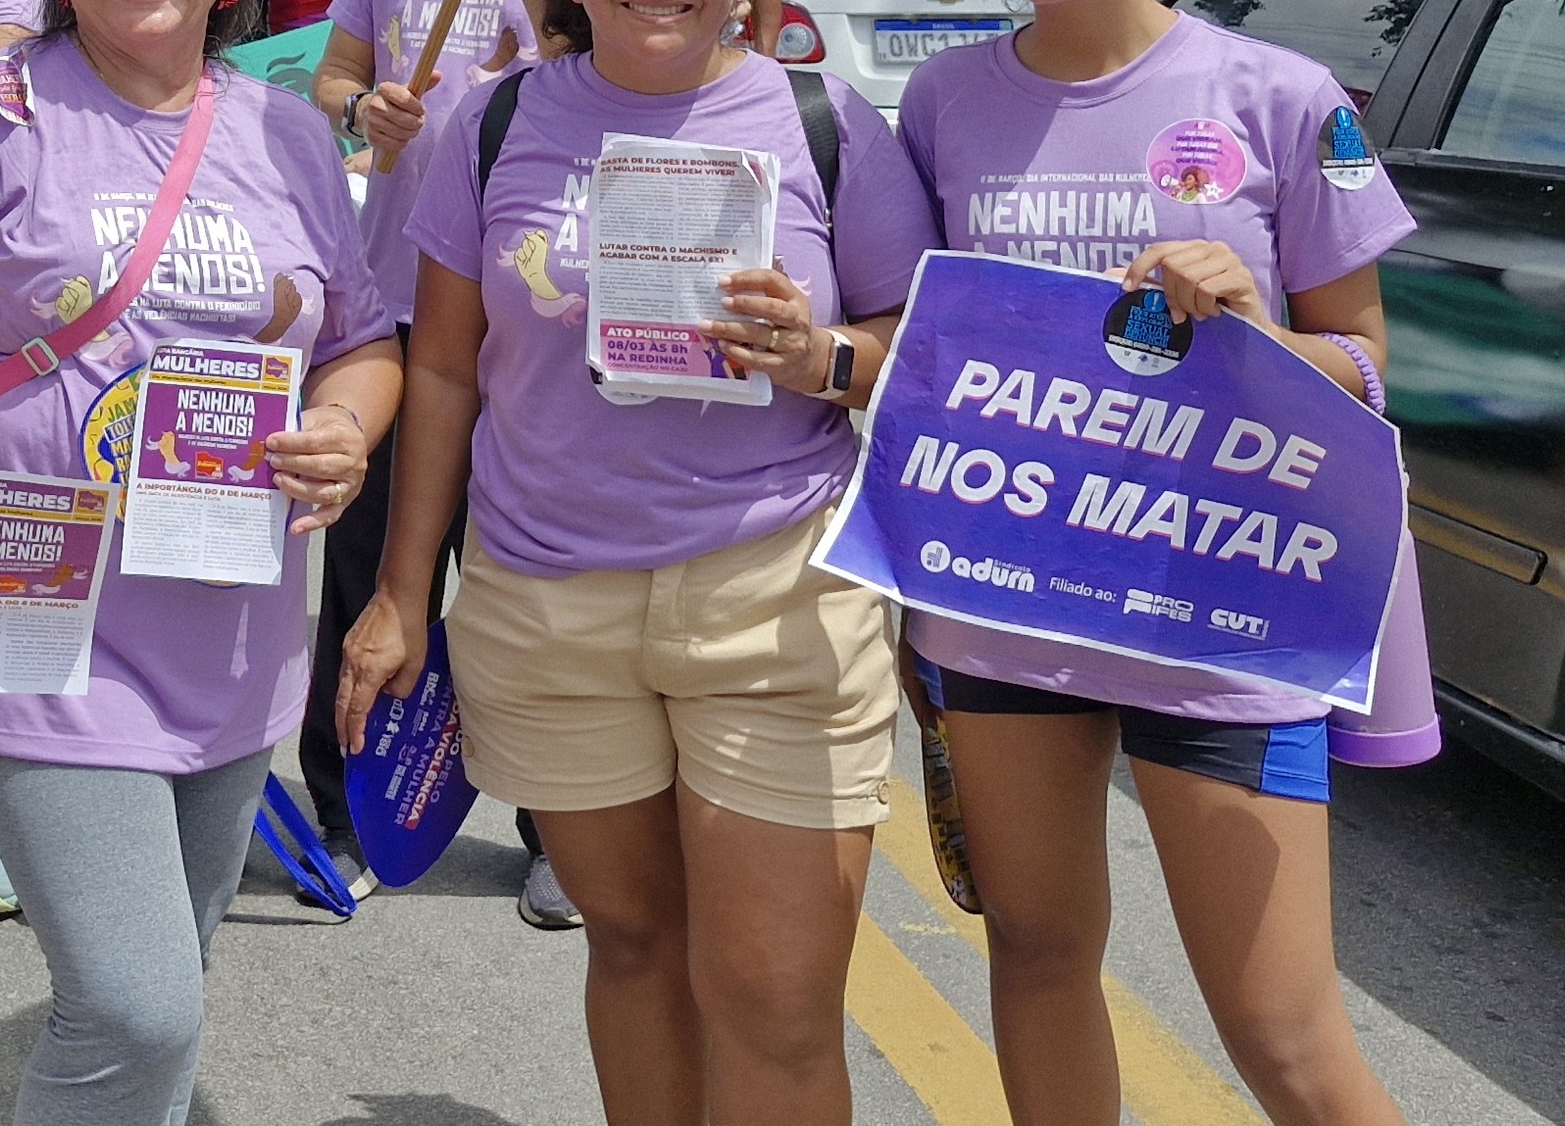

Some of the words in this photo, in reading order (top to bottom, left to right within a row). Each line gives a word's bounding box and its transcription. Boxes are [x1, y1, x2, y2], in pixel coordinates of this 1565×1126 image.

[400, 0, 413, 28] A
[418, 0, 501, 37] MNOS!
[613, 166, 662, 174] MULHERES
[663, 166, 703, 176] QUEREM
[630, 157, 643, 166] DE
[645, 158, 680, 167] FLORES
[968, 190, 1157, 237] NENHUMA
[599, 242, 629, 252] LUTAR
[630, 243, 668, 253] CONTRA
[669, 246, 677, 254] O
[678, 246, 730, 256] MACHISMO
[731, 248, 738, 256] E
[599, 251, 637, 261] ACABAR
[638, 253, 660, 262] COM
[661, 254, 669, 262] A
[670, 255, 706, 264] ESCALA
[141, 253, 267, 295] ENOS!
[607, 326, 632, 338] ATO
[635, 327, 690, 341] PÚBLICO
[607, 340, 645, 352] 08/03
[671, 343, 688, 354] 8h
[152, 354, 260, 379] MULHERES
[607, 352, 626, 362] NA
[629, 353, 688, 366] REDINHA
[177, 388, 256, 416] NENHUMA
[175, 410, 187, 432] A
[191, 412, 254, 437] MENOS!
[946, 359, 1204, 460] PAREM
[1212, 416, 1327, 490] DE
[144, 482, 203, 494] IMPORTÂNCIA
[227, 490, 239, 498] DE
[240, 491, 272, 501] MARÇO
[900, 435, 1055, 518] NOS
[1066, 474, 1339, 582] MATAR
[951, 557, 1036, 593] adurn
[1049, 576, 1093, 598] Filiado
[1094, 587, 1118, 603] ao:
[30, 600, 43, 608] DE
[44, 601, 80, 610] MARÇO
[394, 752, 431, 826] MULHER
[408, 729, 451, 822] VIOLÊNCIA
[430, 758, 454, 804] PELO
